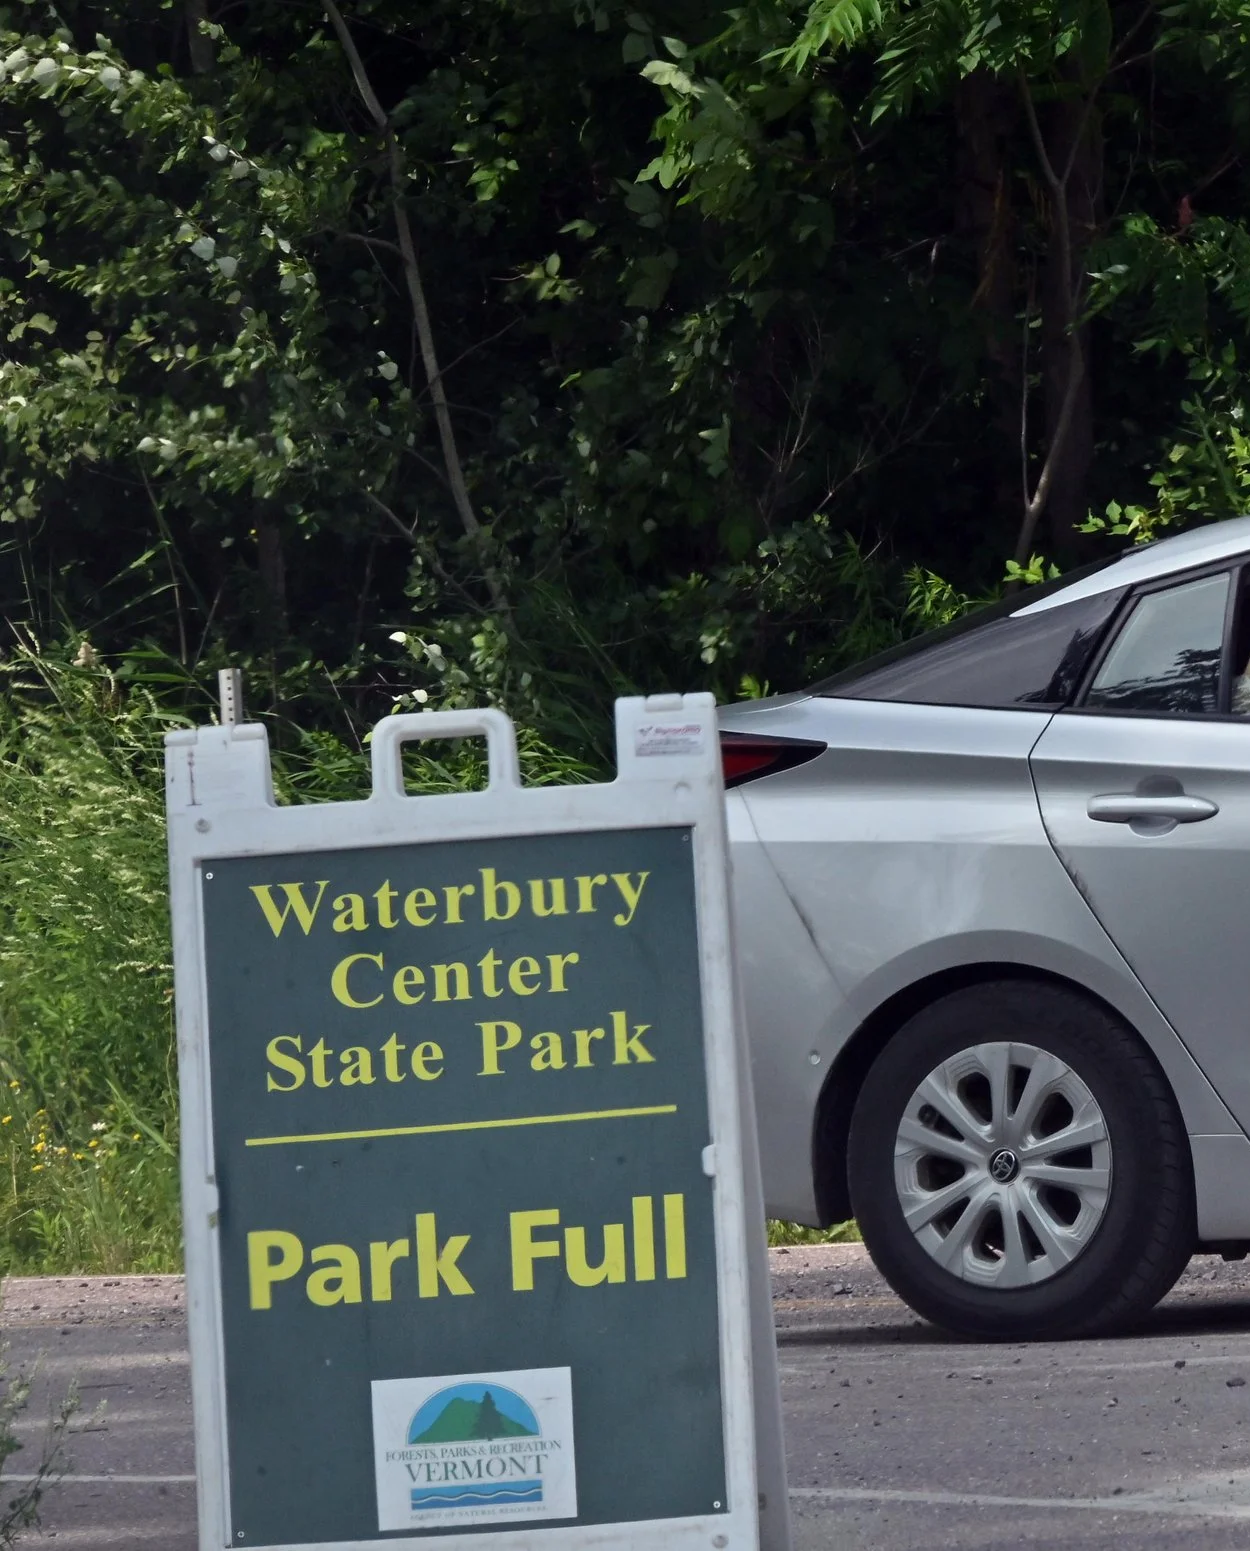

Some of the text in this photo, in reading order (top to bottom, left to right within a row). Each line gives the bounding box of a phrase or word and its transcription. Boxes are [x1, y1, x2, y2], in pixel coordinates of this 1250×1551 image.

[250, 868, 650, 938] Waterbury
[331, 948, 580, 1009] Center
[266, 1011, 656, 1093] State Park
[247, 1193, 687, 1310] Park Full
[385, 1447, 438, 1462] FORESTS,
[440, 1446, 477, 1458] PARKS
[489, 1440, 561, 1455] RECREATION
[405, 1454, 548, 1482] VERMONT
